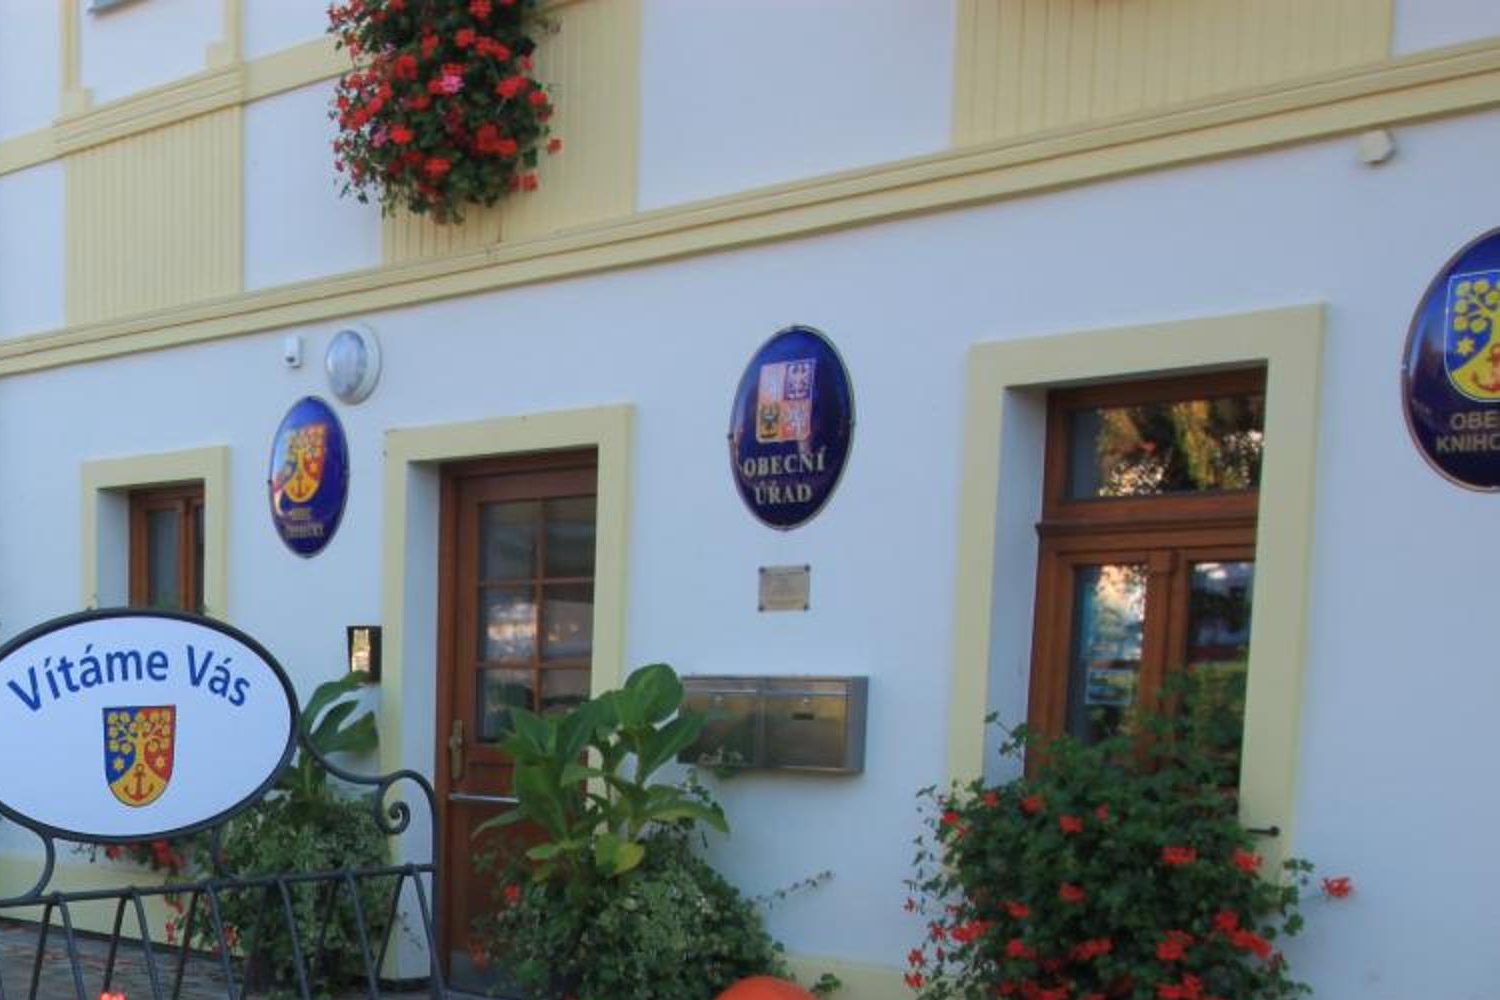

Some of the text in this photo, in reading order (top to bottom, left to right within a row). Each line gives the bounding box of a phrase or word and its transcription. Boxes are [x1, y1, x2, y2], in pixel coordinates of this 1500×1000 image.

[743, 446, 827, 478] OBECNÍ
[755, 479, 812, 505] ÚŘAD
[7, 643, 250, 712] Vítáme Vás
